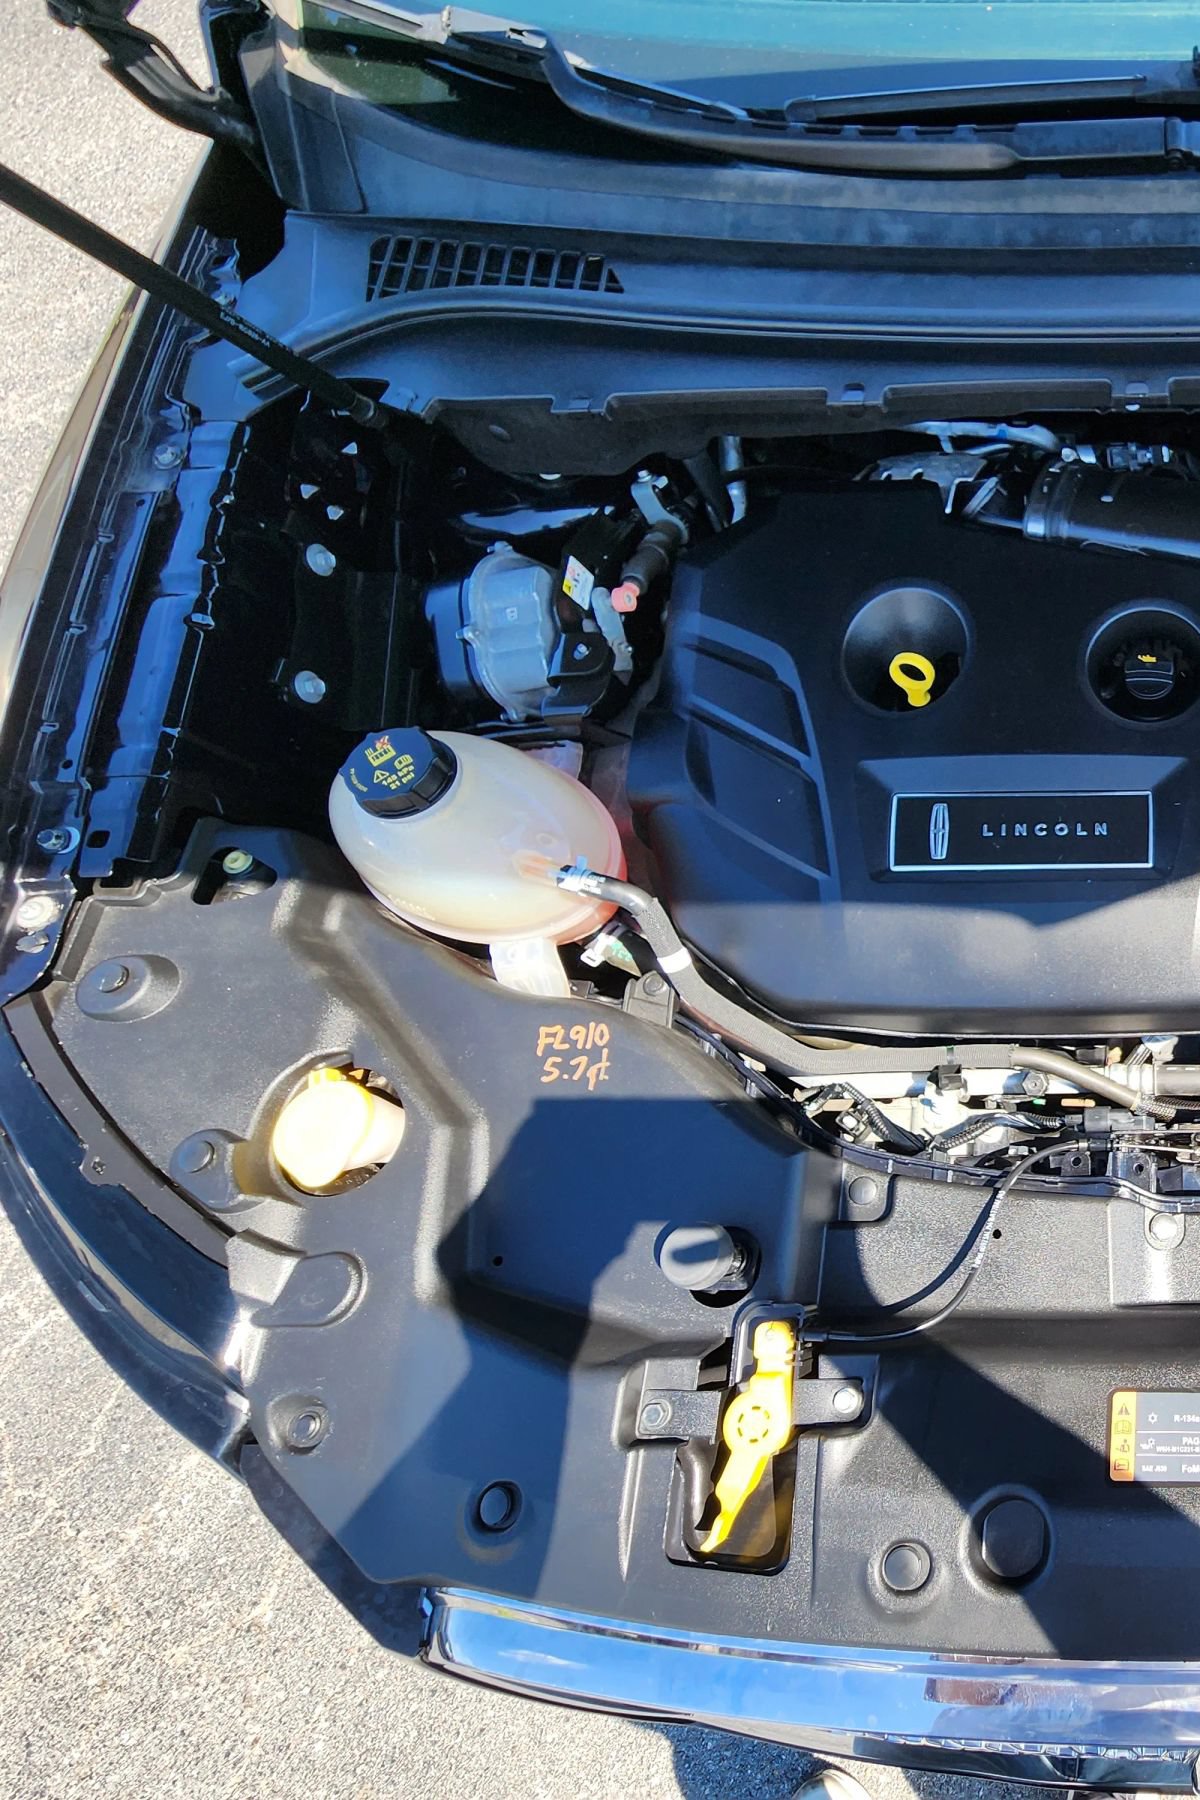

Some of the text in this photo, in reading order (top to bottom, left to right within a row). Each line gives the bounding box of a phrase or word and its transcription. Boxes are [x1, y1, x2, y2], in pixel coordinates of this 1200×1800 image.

[982, 822, 1108, 837] LINCOLN
[1173, 1414, 1200, 1423] R-134a
[1182, 1436, 1200, 1445] PAG
